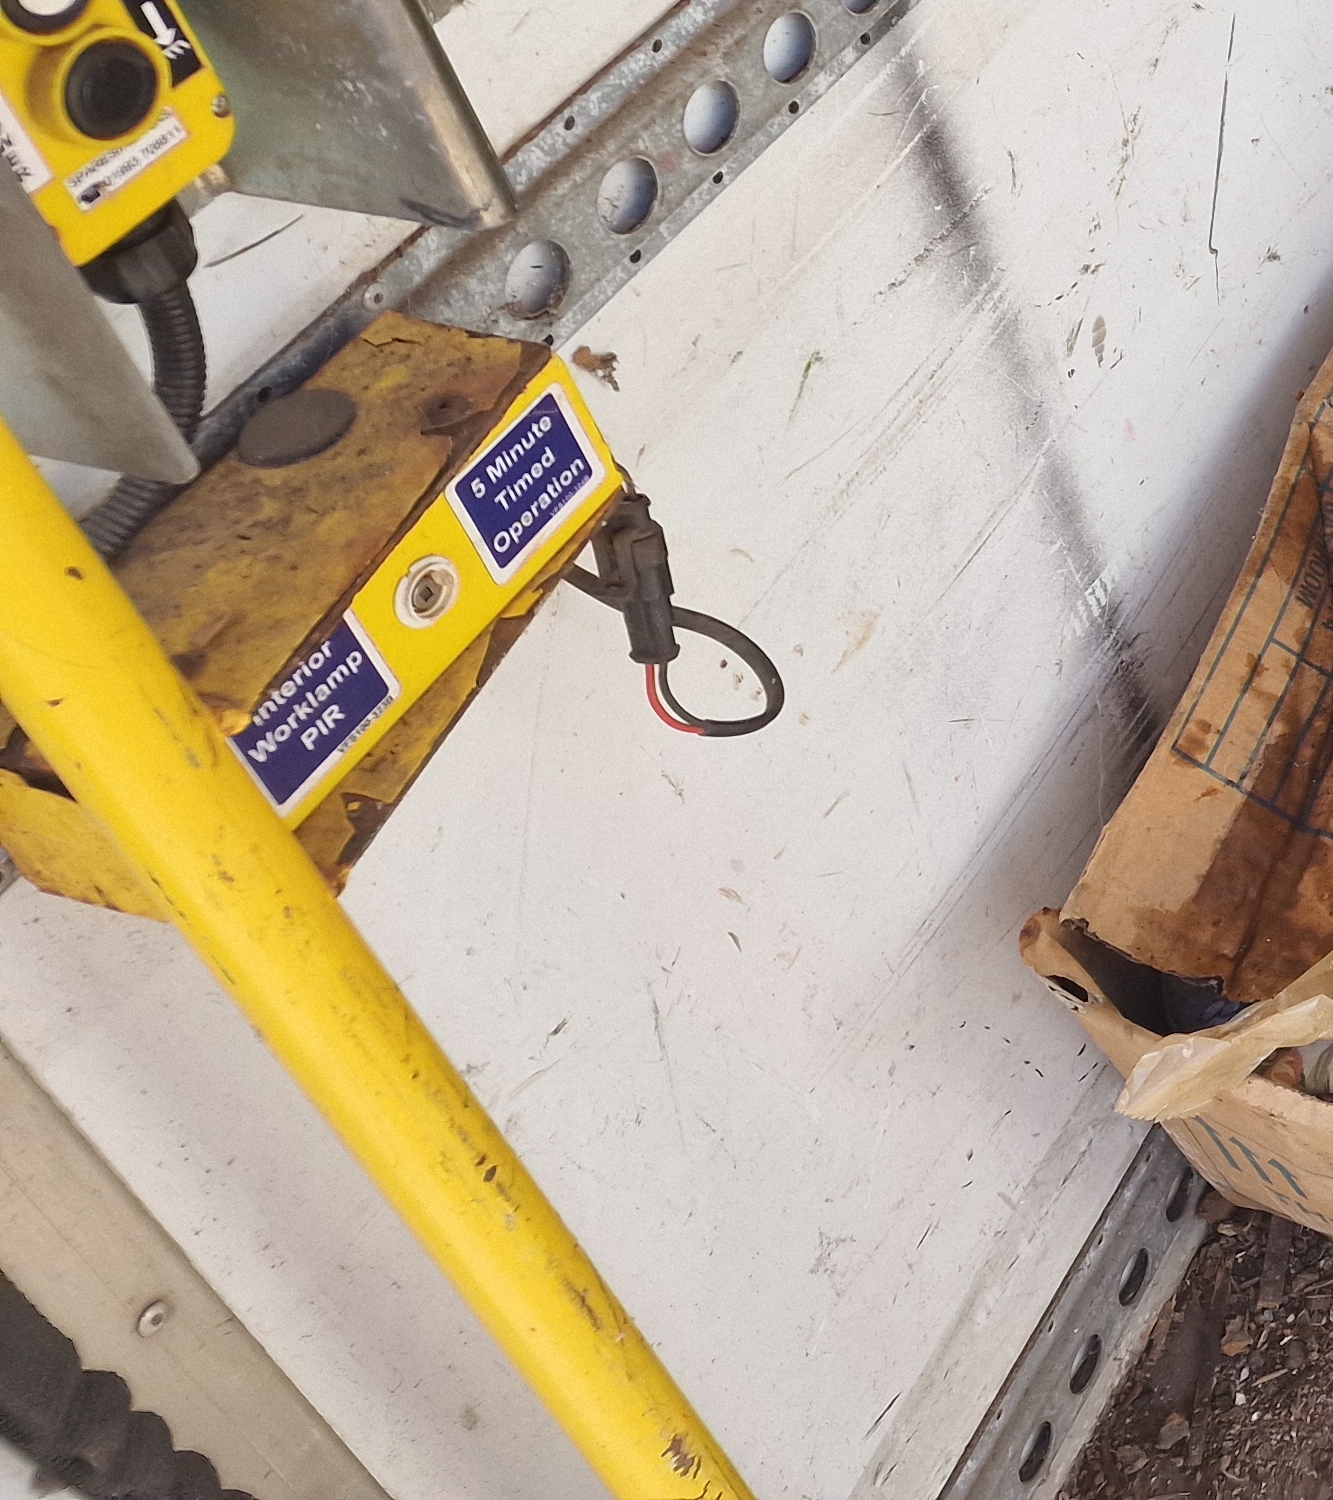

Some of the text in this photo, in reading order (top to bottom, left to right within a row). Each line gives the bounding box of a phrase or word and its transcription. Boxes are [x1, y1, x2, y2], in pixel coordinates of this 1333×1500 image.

[471, 416, 552, 498] 5 Minute
[494, 446, 556, 511] Timed
[493, 458, 585, 553] Operation
[248, 650, 363, 763] Worklamp
[300, 704, 346, 750] PIR
